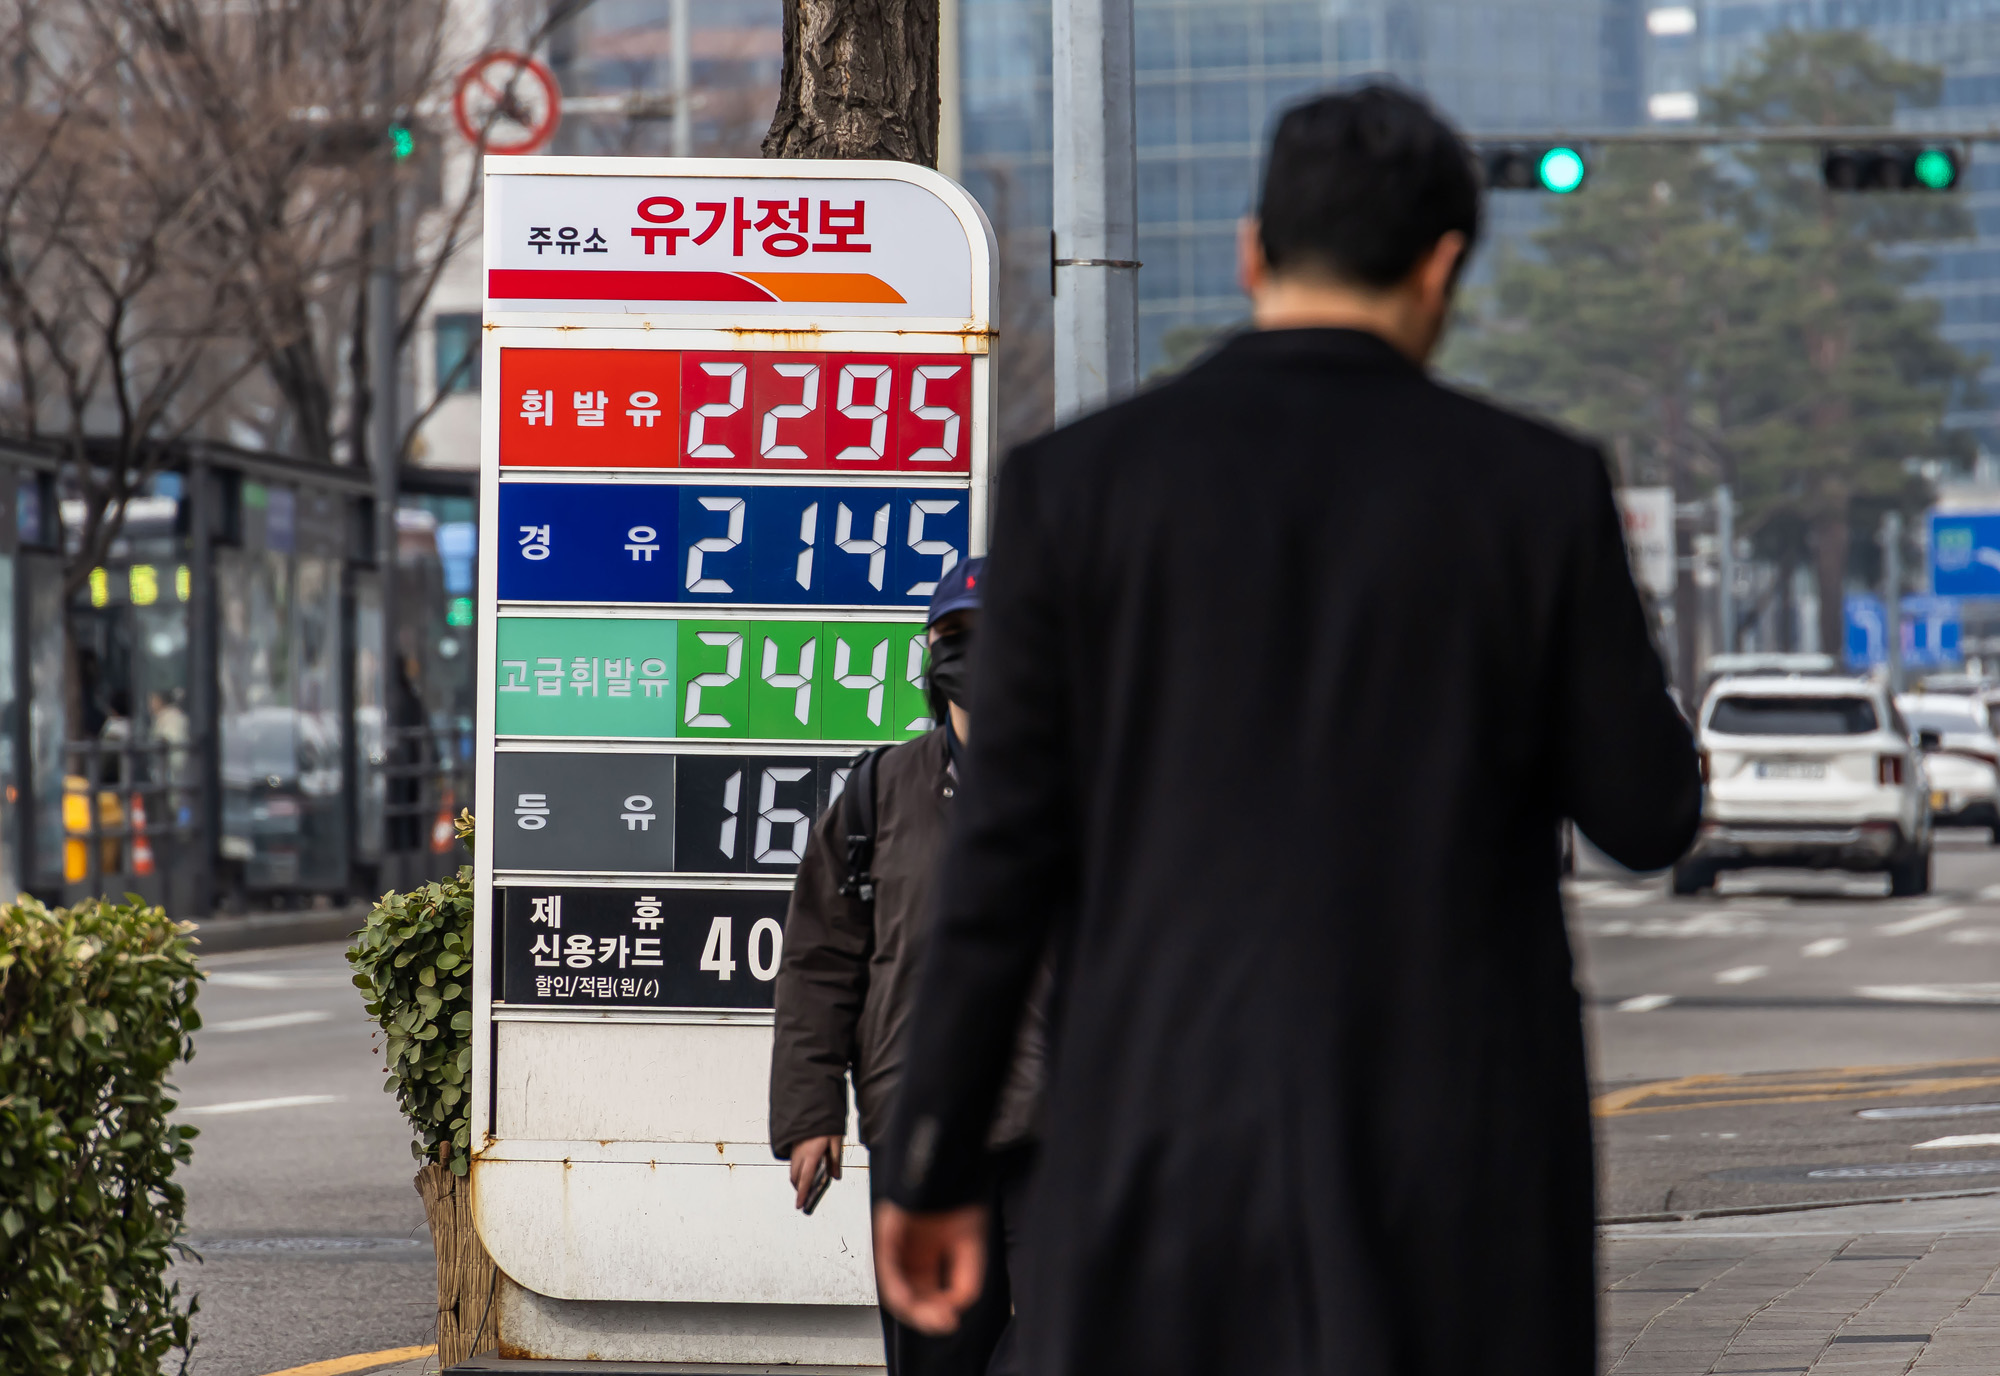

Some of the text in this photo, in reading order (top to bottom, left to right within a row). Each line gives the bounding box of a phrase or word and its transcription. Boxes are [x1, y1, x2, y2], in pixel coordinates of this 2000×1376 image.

[527, 196, 872, 258] 주유소 유가정보
[686, 362, 962, 461] 2295
[685, 496, 960, 596] 2145
[499, 656, 670, 698] 고급휘발유
[529, 934, 664, 969] 신용카드
